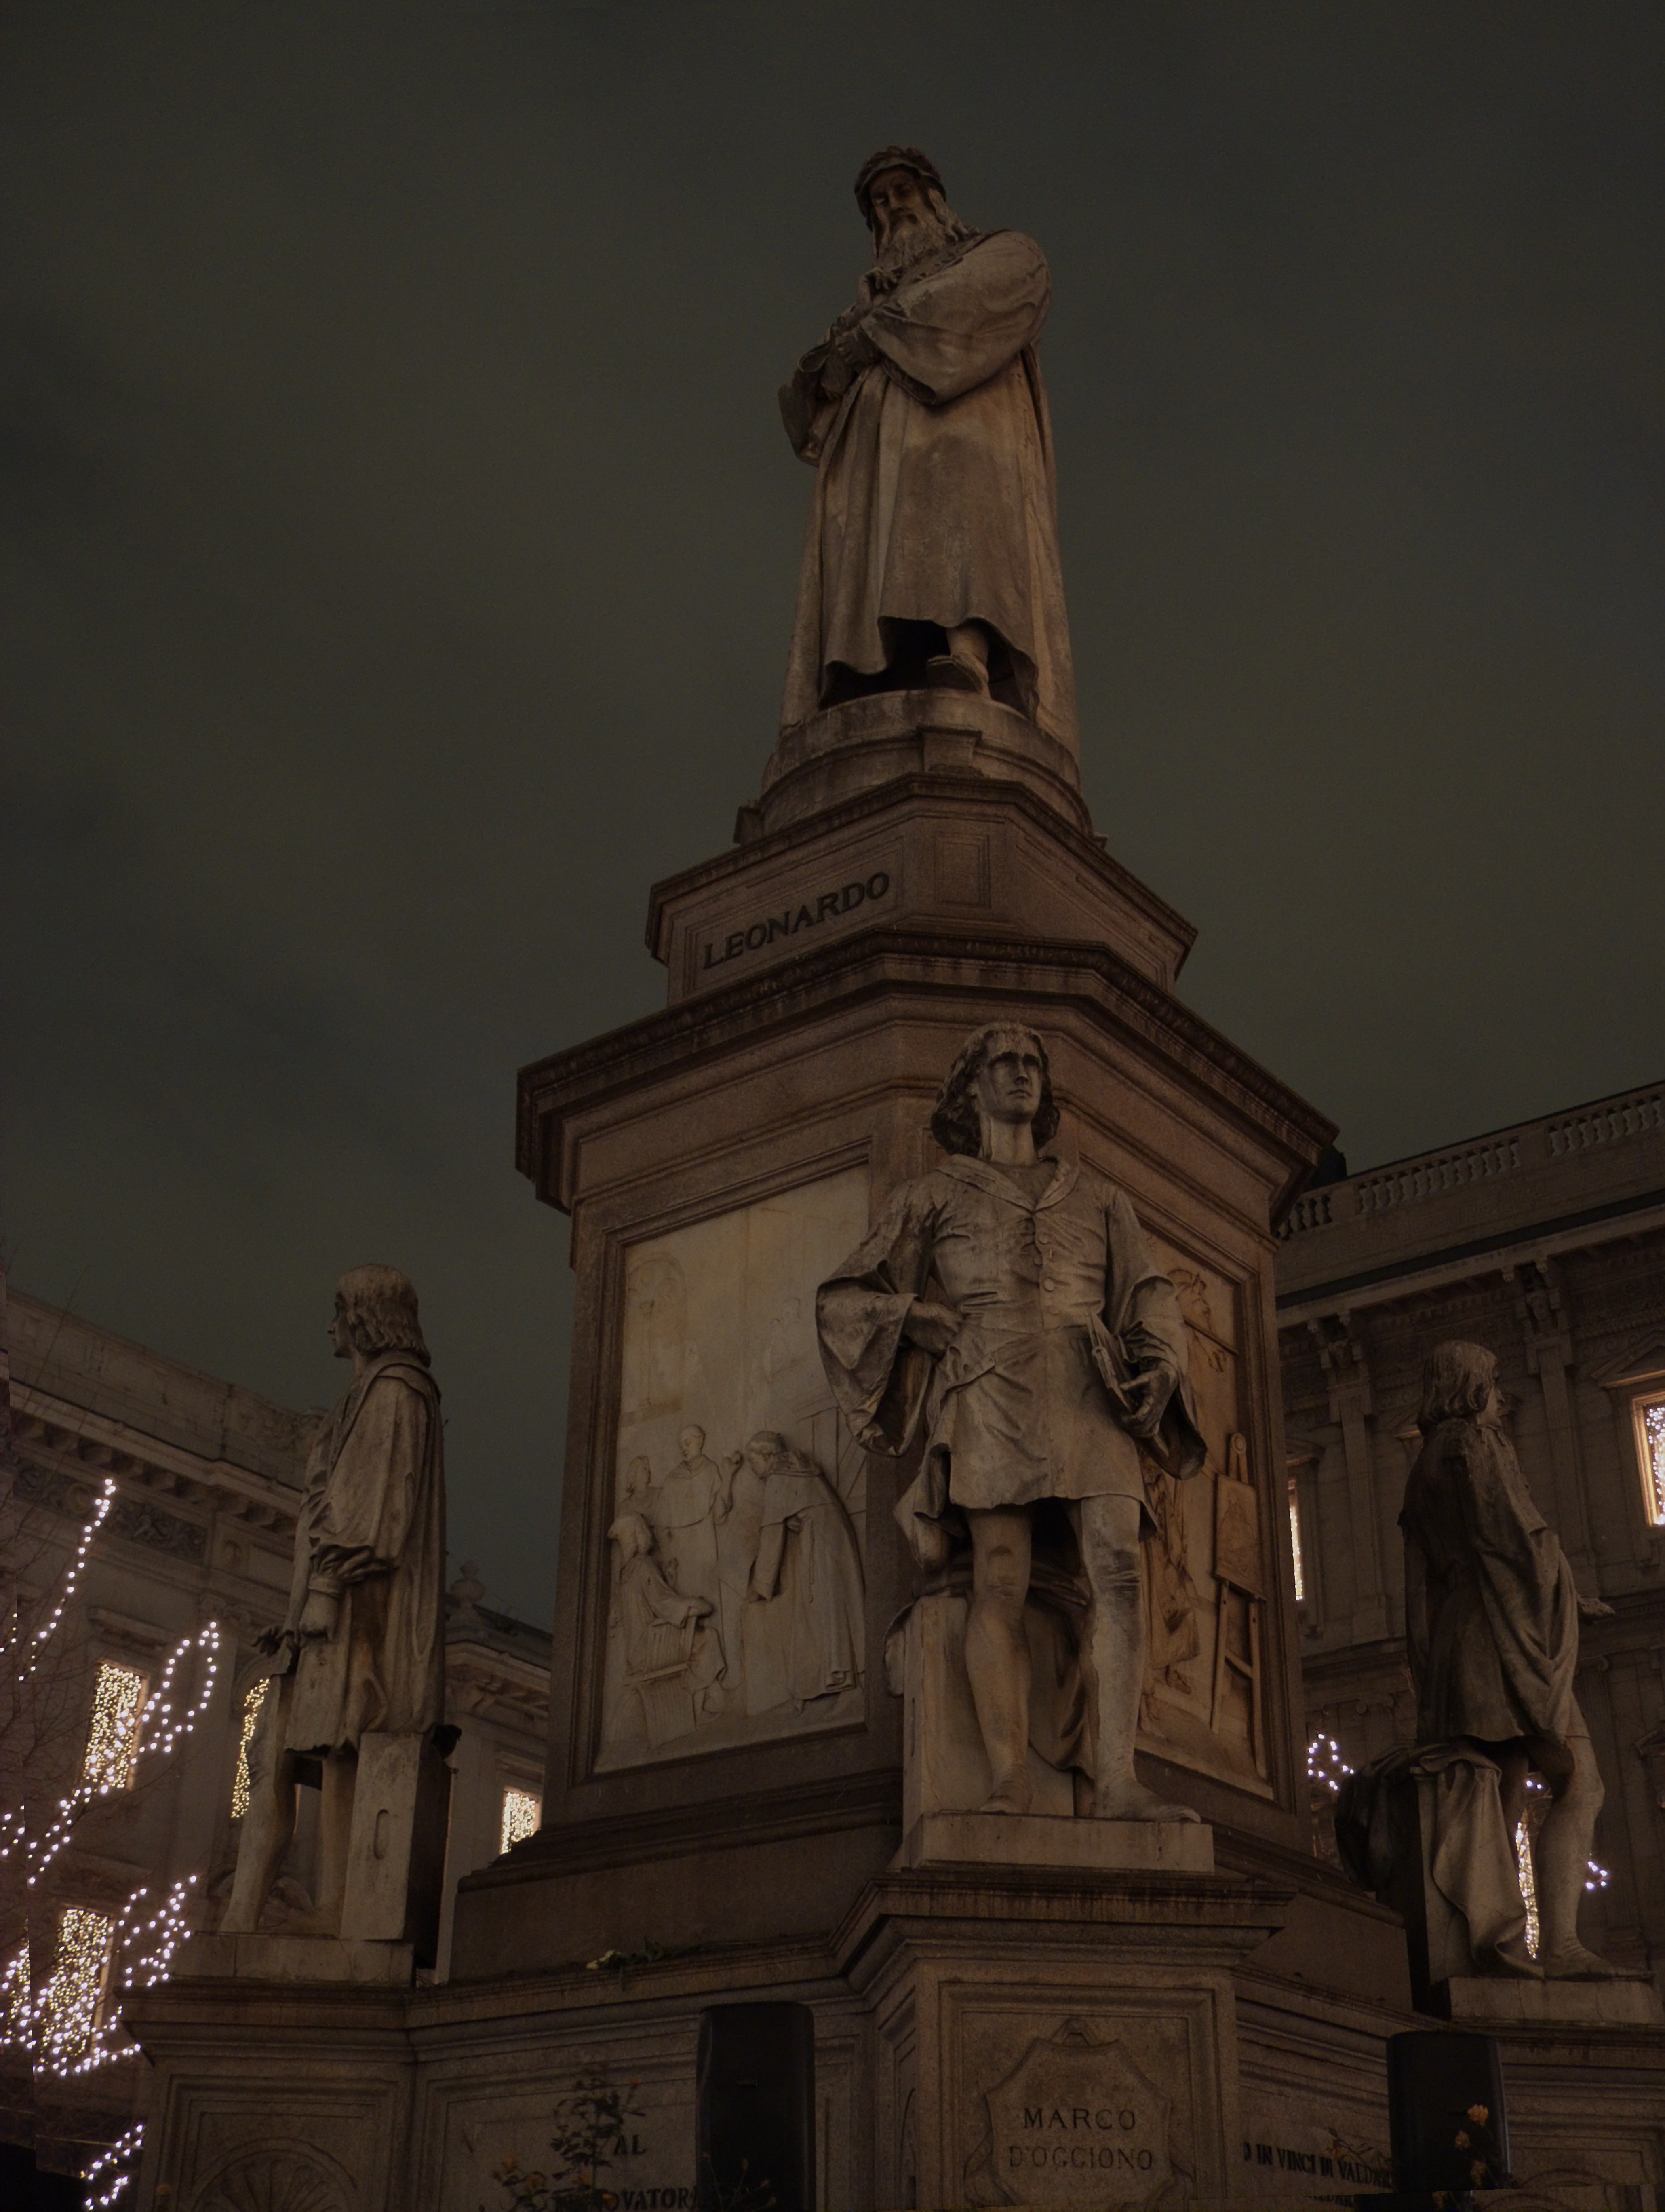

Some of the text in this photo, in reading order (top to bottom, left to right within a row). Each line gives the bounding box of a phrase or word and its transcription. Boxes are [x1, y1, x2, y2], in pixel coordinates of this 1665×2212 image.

[703, 872, 889, 969] LEONARDO
[1024, 2107, 1135, 2130] MARCO
[613, 2135, 647, 2155] AL
[1256, 2144, 1273, 2166] IN
[1277, 2147, 1317, 2174] VINCI
[1319, 2157, 1334, 2178] DI
